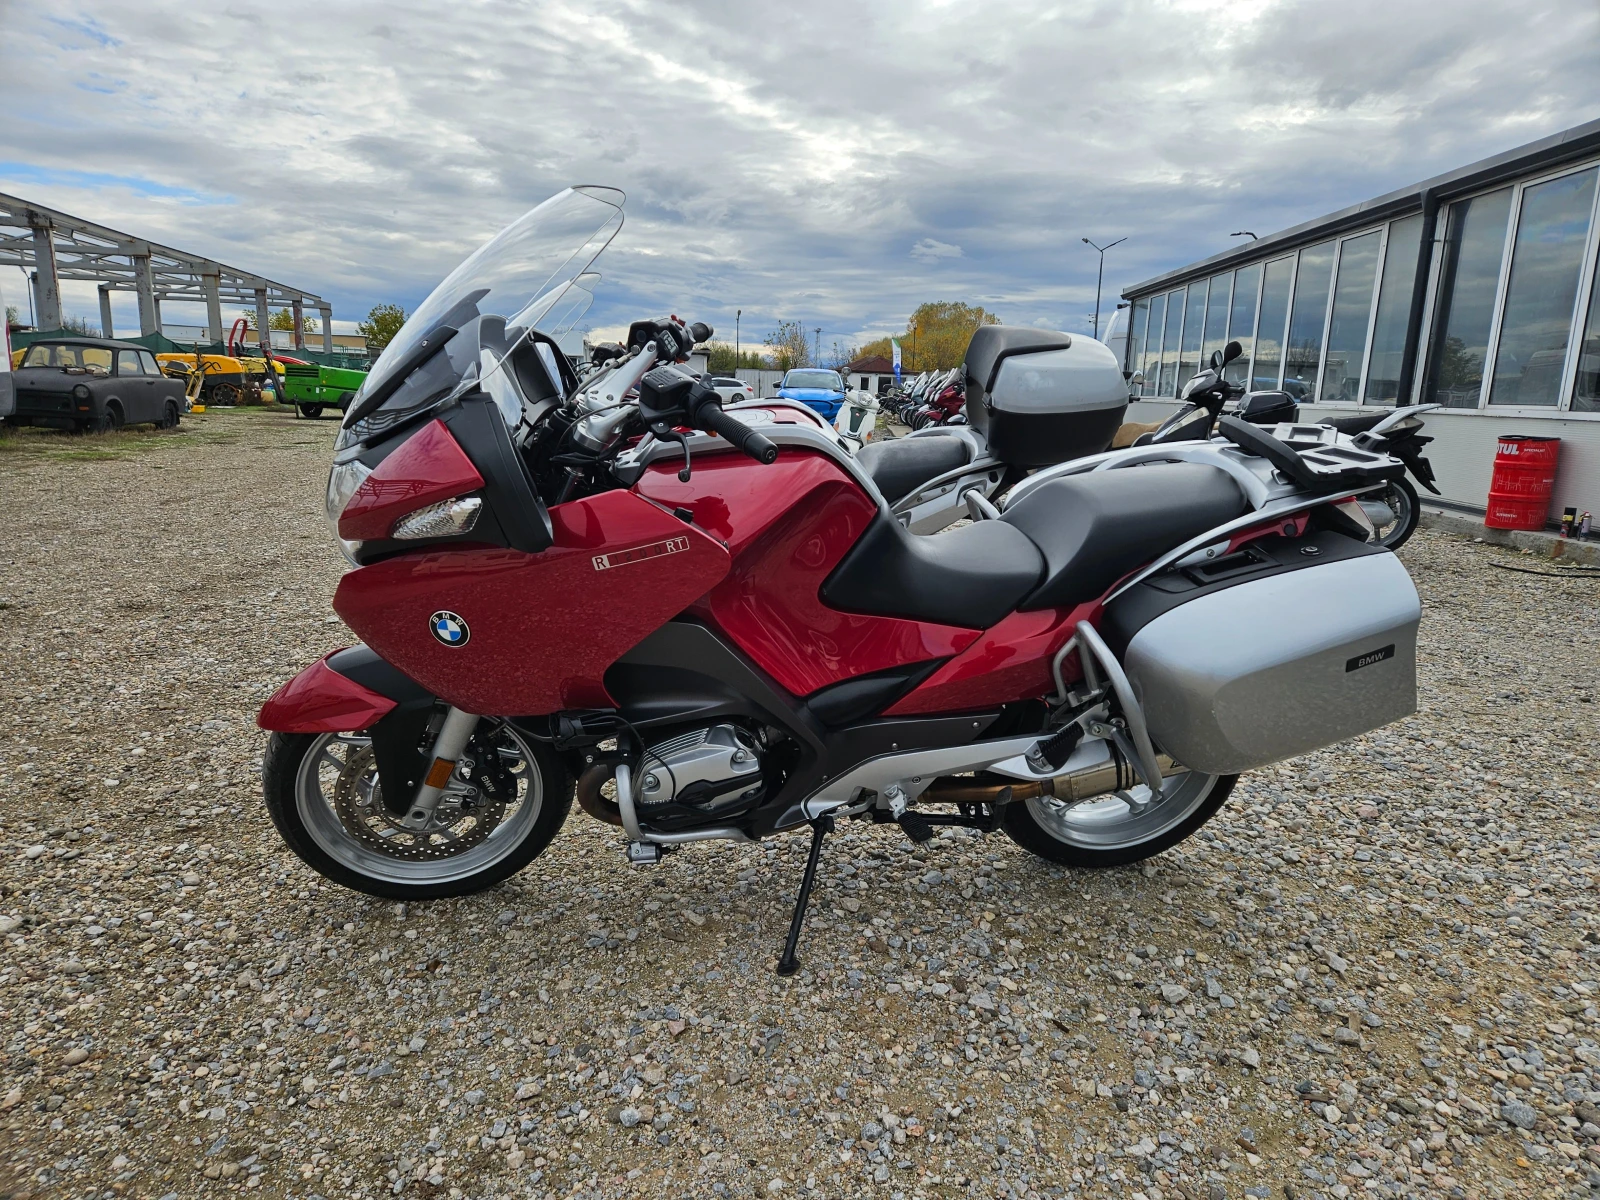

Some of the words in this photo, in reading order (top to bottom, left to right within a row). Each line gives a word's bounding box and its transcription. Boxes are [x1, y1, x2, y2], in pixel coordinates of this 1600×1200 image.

[594, 556, 606, 569] R
[666, 538, 684, 553] RT
[432, 612, 464, 626] BMW
[1359, 651, 1385, 667] BMW
[480, 775, 496, 792] BMW
